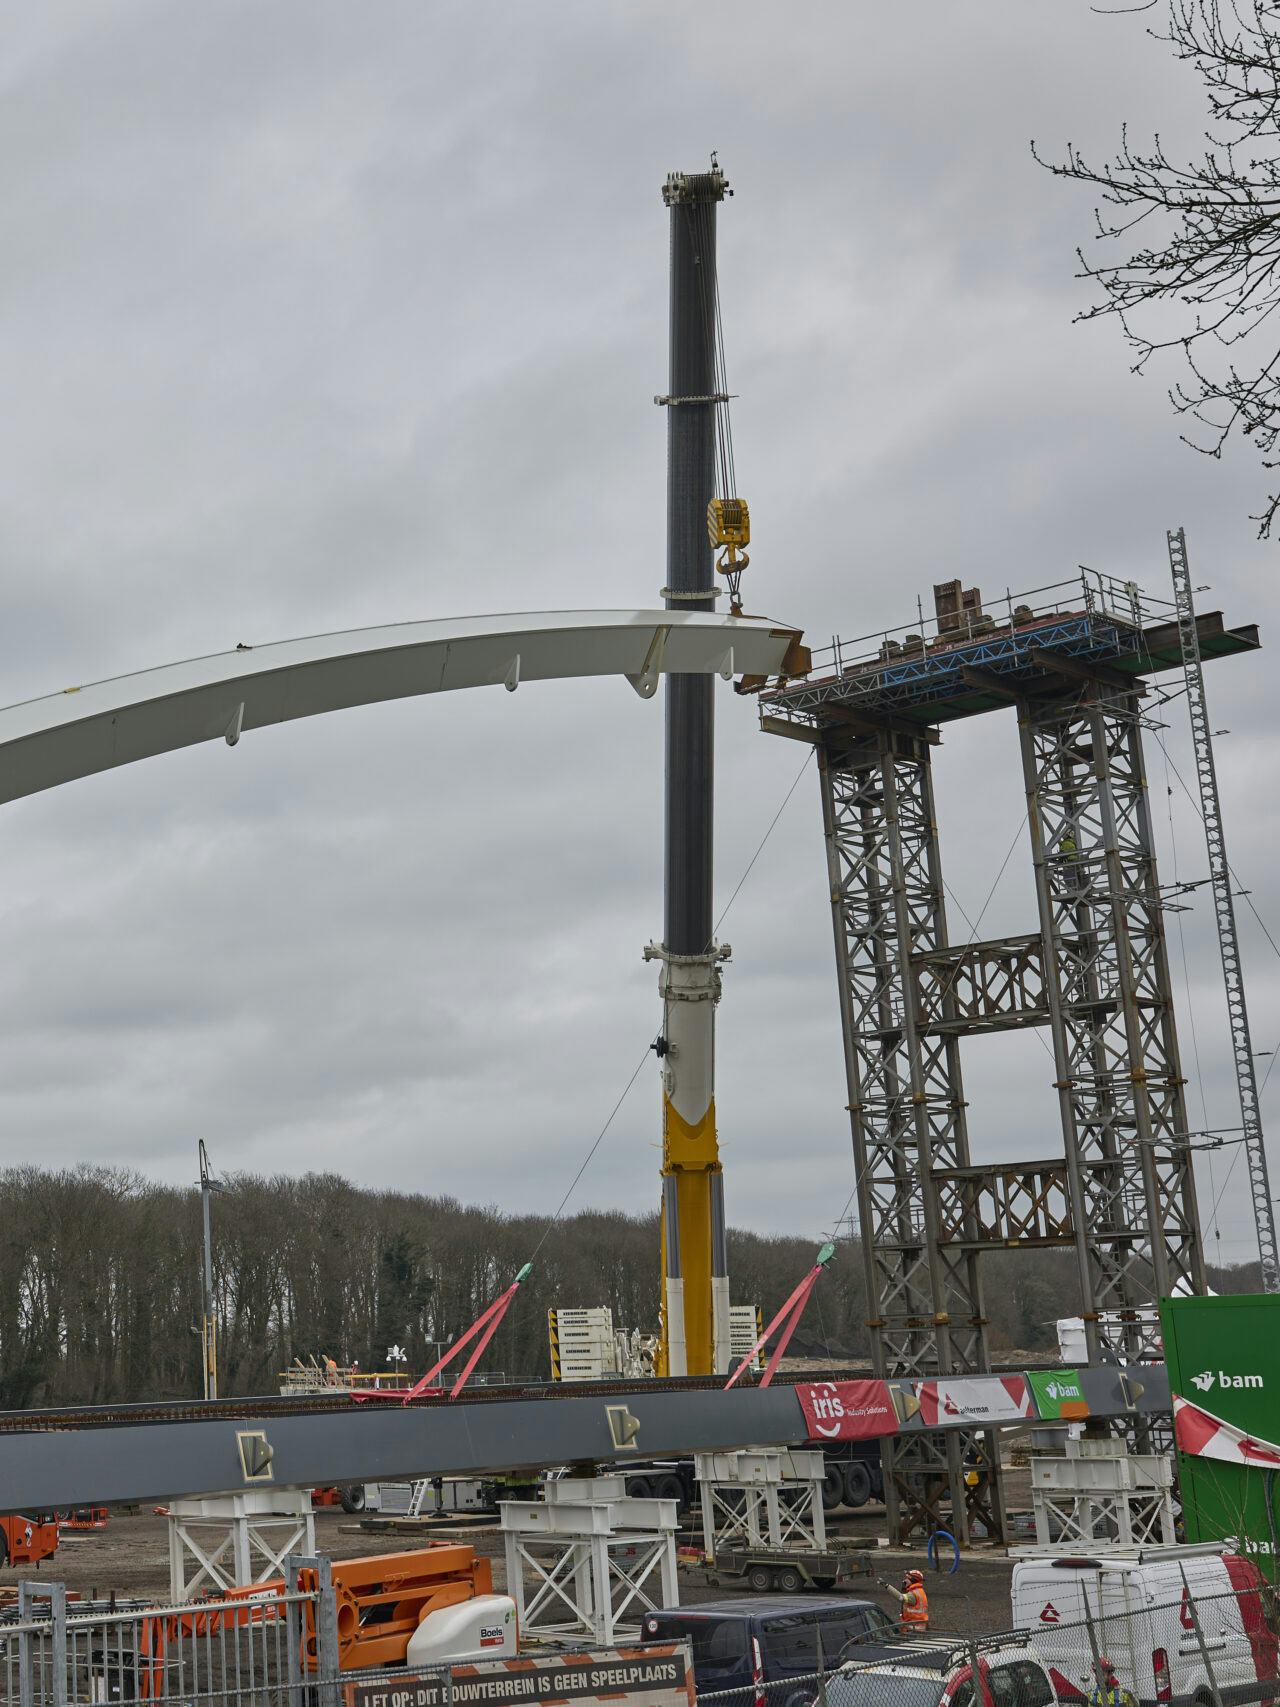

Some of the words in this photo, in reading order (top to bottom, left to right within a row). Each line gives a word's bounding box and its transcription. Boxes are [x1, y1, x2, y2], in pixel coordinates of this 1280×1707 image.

[1218, 1370, 1264, 1388] bam
[1057, 1382, 1080, 1397] bam
[810, 1389, 845, 1419] iris
[480, 1628, 503, 1638] Boels
[392, 1691, 414, 1707] OP:
[417, 1688, 438, 1706] DIT
[538, 1676, 551, 1693] IS
[554, 1672, 588, 1691] GEEN
[591, 1663, 677, 1687] SPEELPLAATS
